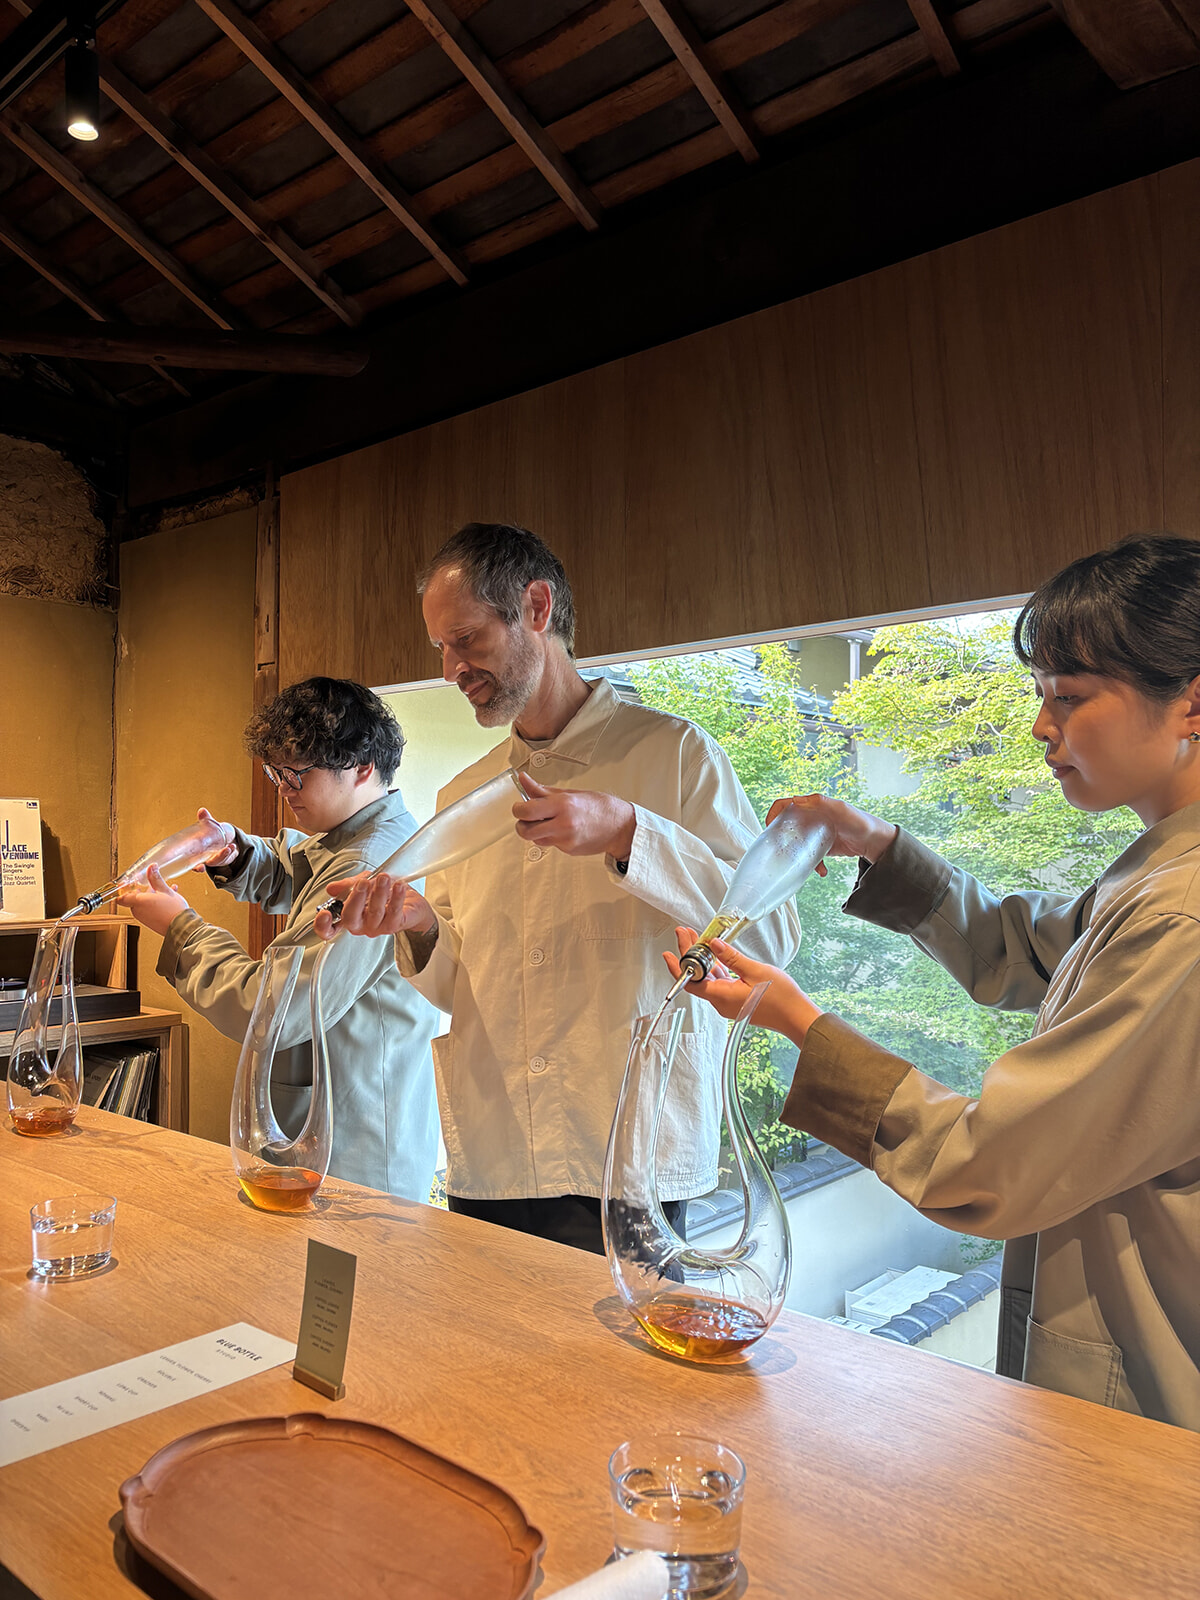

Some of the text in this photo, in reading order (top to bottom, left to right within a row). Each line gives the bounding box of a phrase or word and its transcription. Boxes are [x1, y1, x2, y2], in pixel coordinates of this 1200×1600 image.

[216, 1339, 263, 1361] BLUE BOTTLE
[216, 1349, 237, 1360] STUDIO
